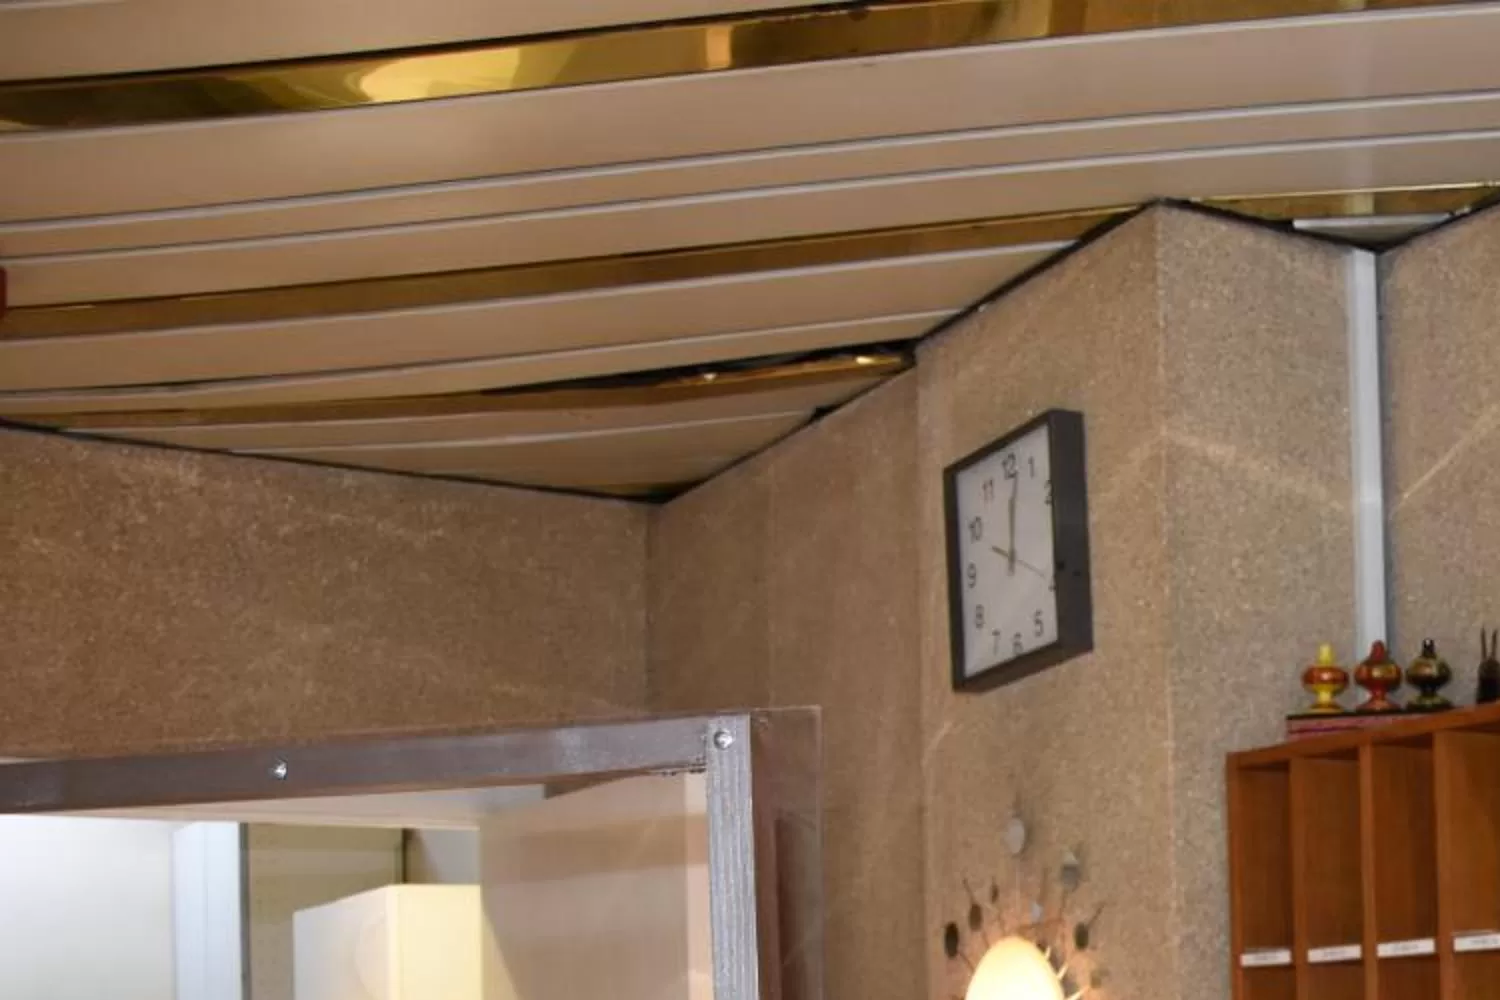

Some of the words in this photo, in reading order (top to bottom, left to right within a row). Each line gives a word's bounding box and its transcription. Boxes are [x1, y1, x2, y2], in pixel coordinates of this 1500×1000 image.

[1001, 452, 1019, 480] 12
[1027, 456, 1036, 478] 1
[981, 479, 995, 503] 11
[968, 516, 983, 542] 10
[966, 563, 977, 588] 9
[974, 604, 985, 629] 8
[1033, 610, 1044, 637] 5
[991, 629, 1001, 655] 7
[1013, 632, 1024, 655] 6
